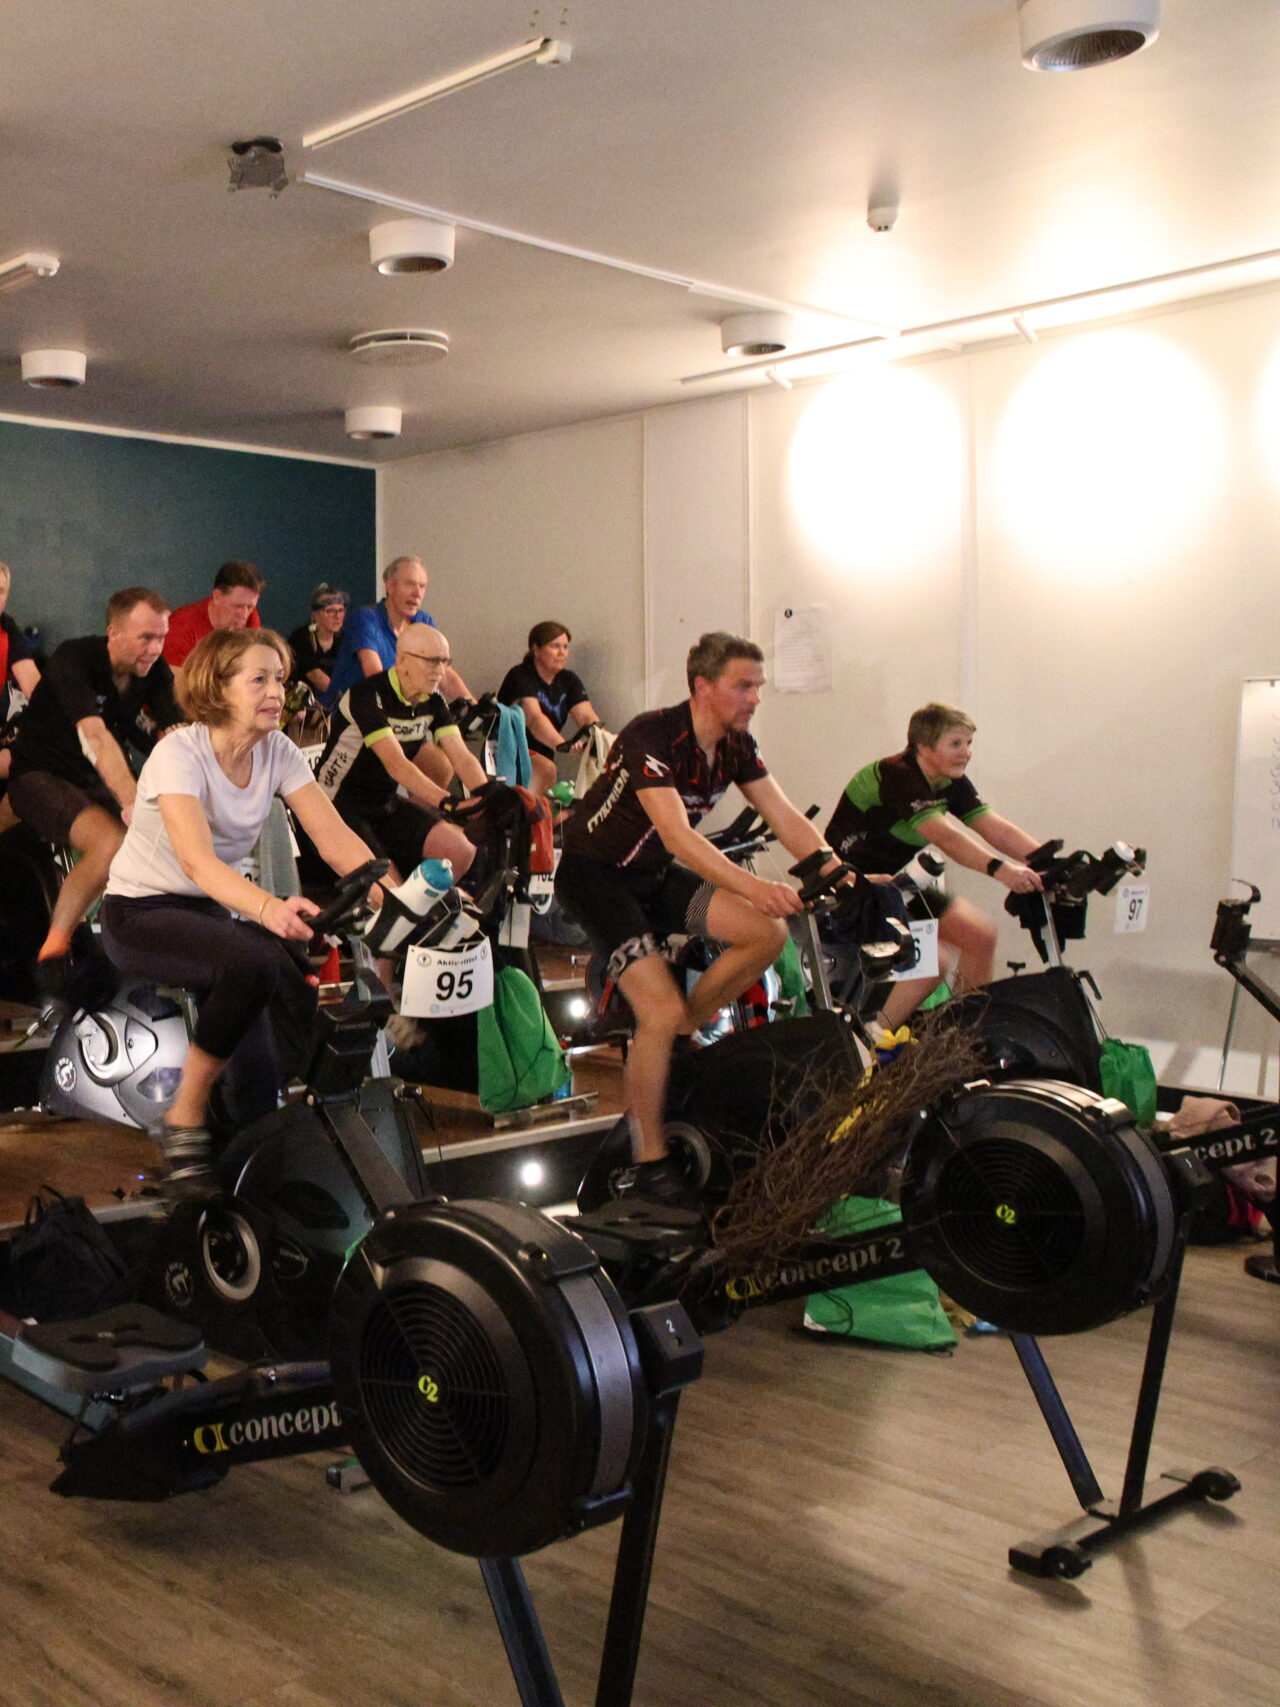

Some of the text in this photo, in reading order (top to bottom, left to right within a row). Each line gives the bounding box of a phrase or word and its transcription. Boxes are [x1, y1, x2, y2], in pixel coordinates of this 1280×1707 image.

[587, 768, 630, 834] MERIDA
[1128, 898, 1143, 921] 97
[435, 968, 474, 1002] 95
[1194, 1127, 1279, 1160] cept 2
[885, 1237, 905, 1260] 2
[418, 1374, 439, 1403] C2
[228, 1400, 343, 1446] concept
